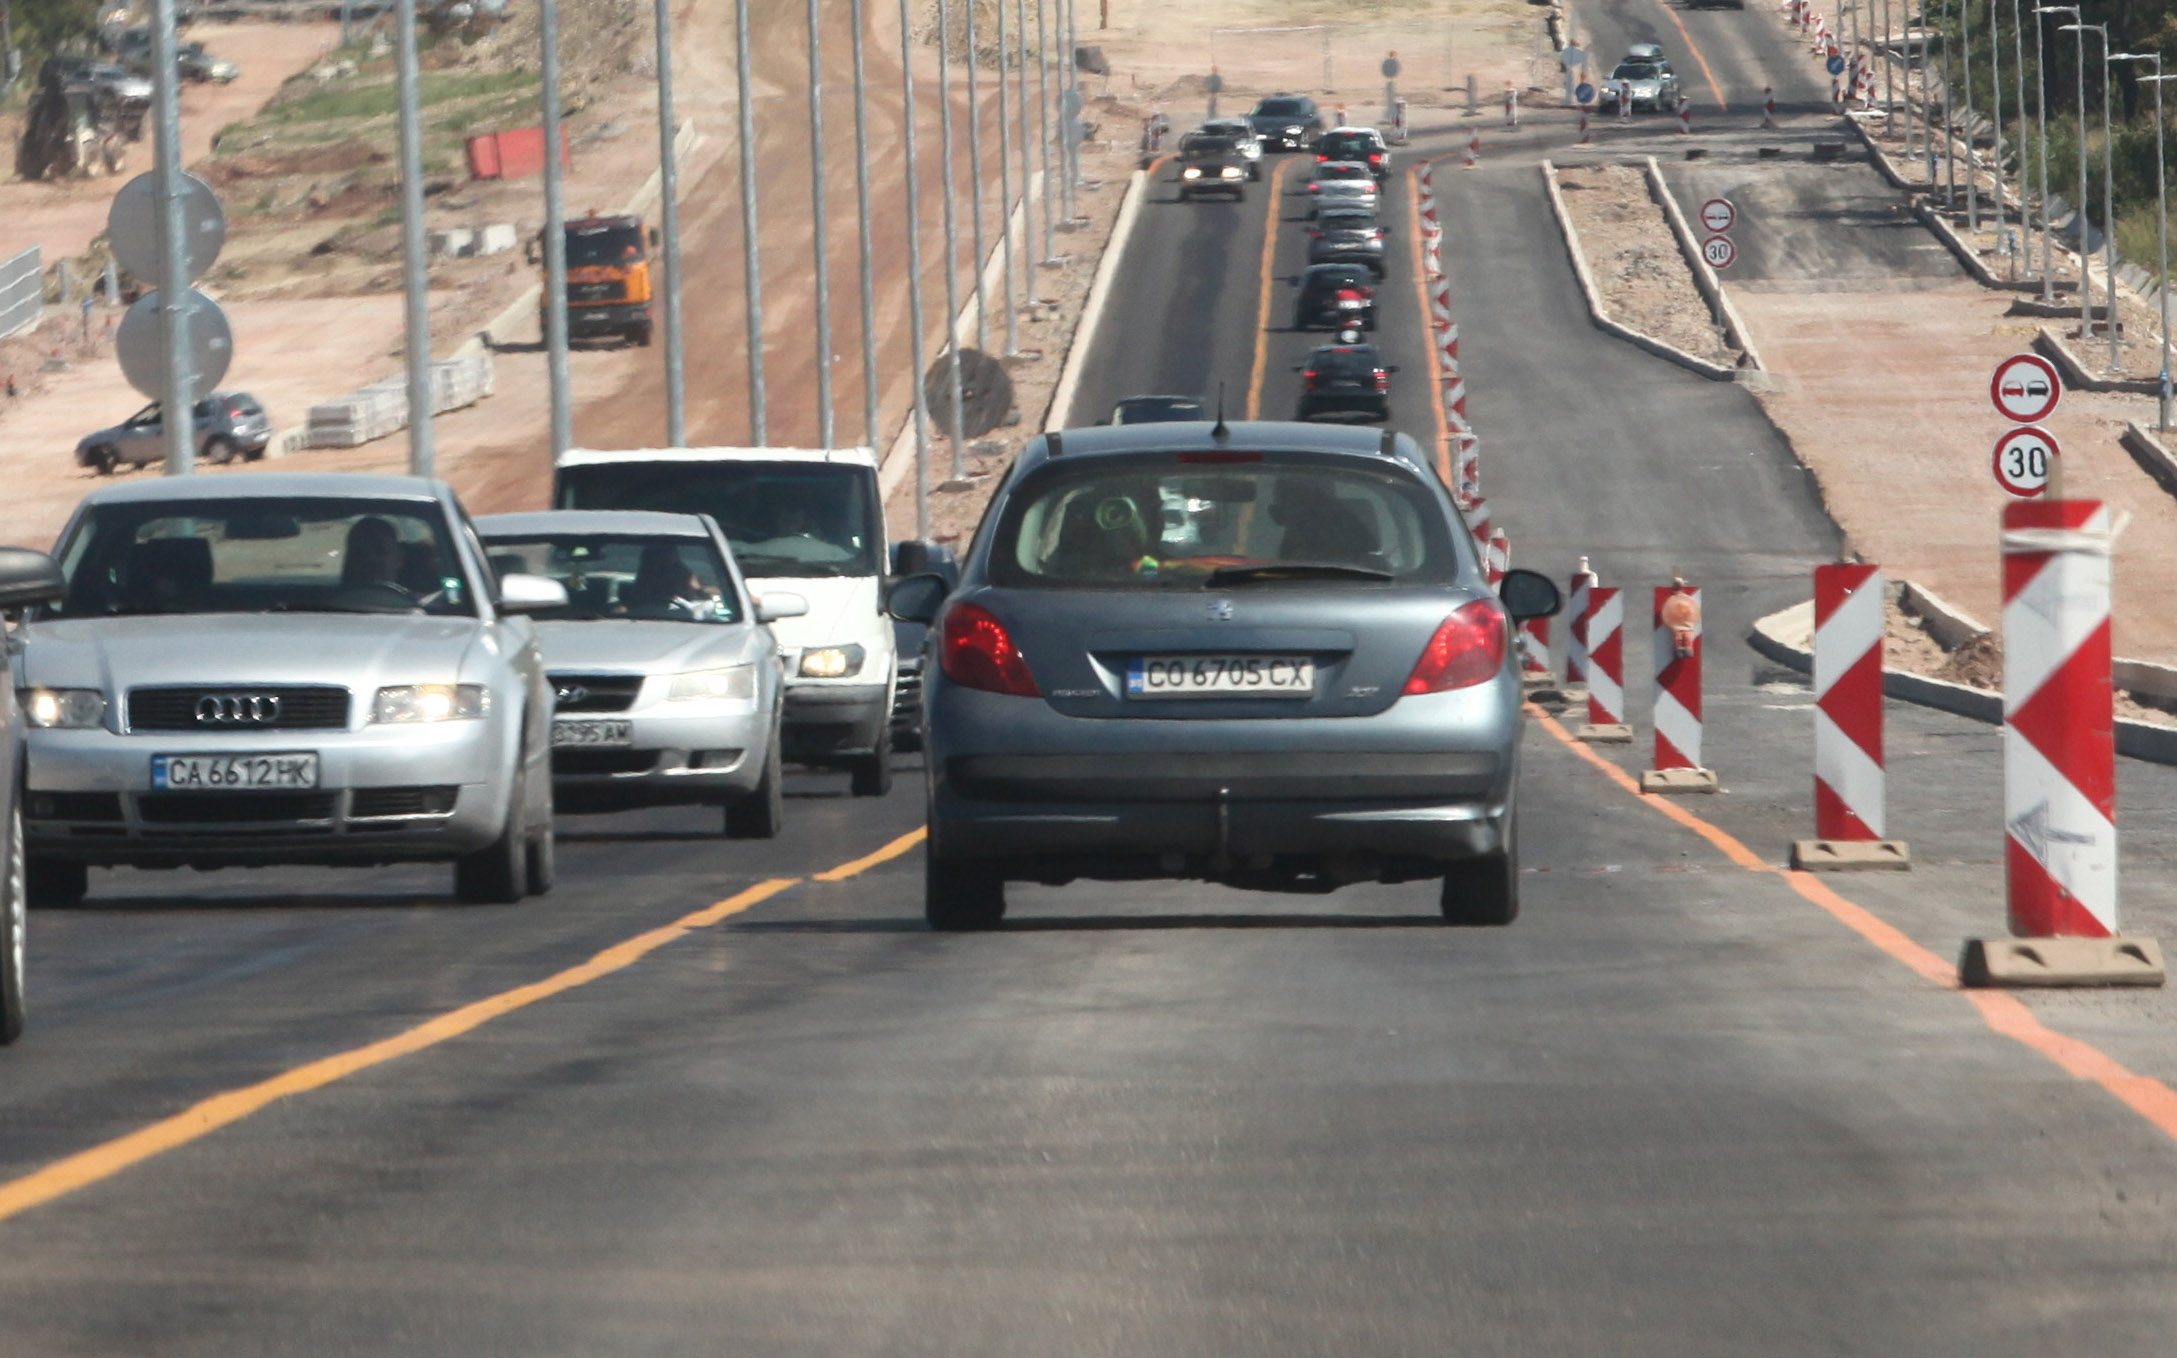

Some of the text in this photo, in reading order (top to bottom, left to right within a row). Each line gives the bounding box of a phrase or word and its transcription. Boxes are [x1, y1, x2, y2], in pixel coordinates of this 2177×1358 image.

[1709, 243, 1729, 260] 30
[2008, 446, 2048, 478] 30
[1192, 659, 1262, 687] 6705
[1269, 660, 1307, 687] CX
[170, 759, 202, 785] CA
[208, 757, 272, 785] 6612
